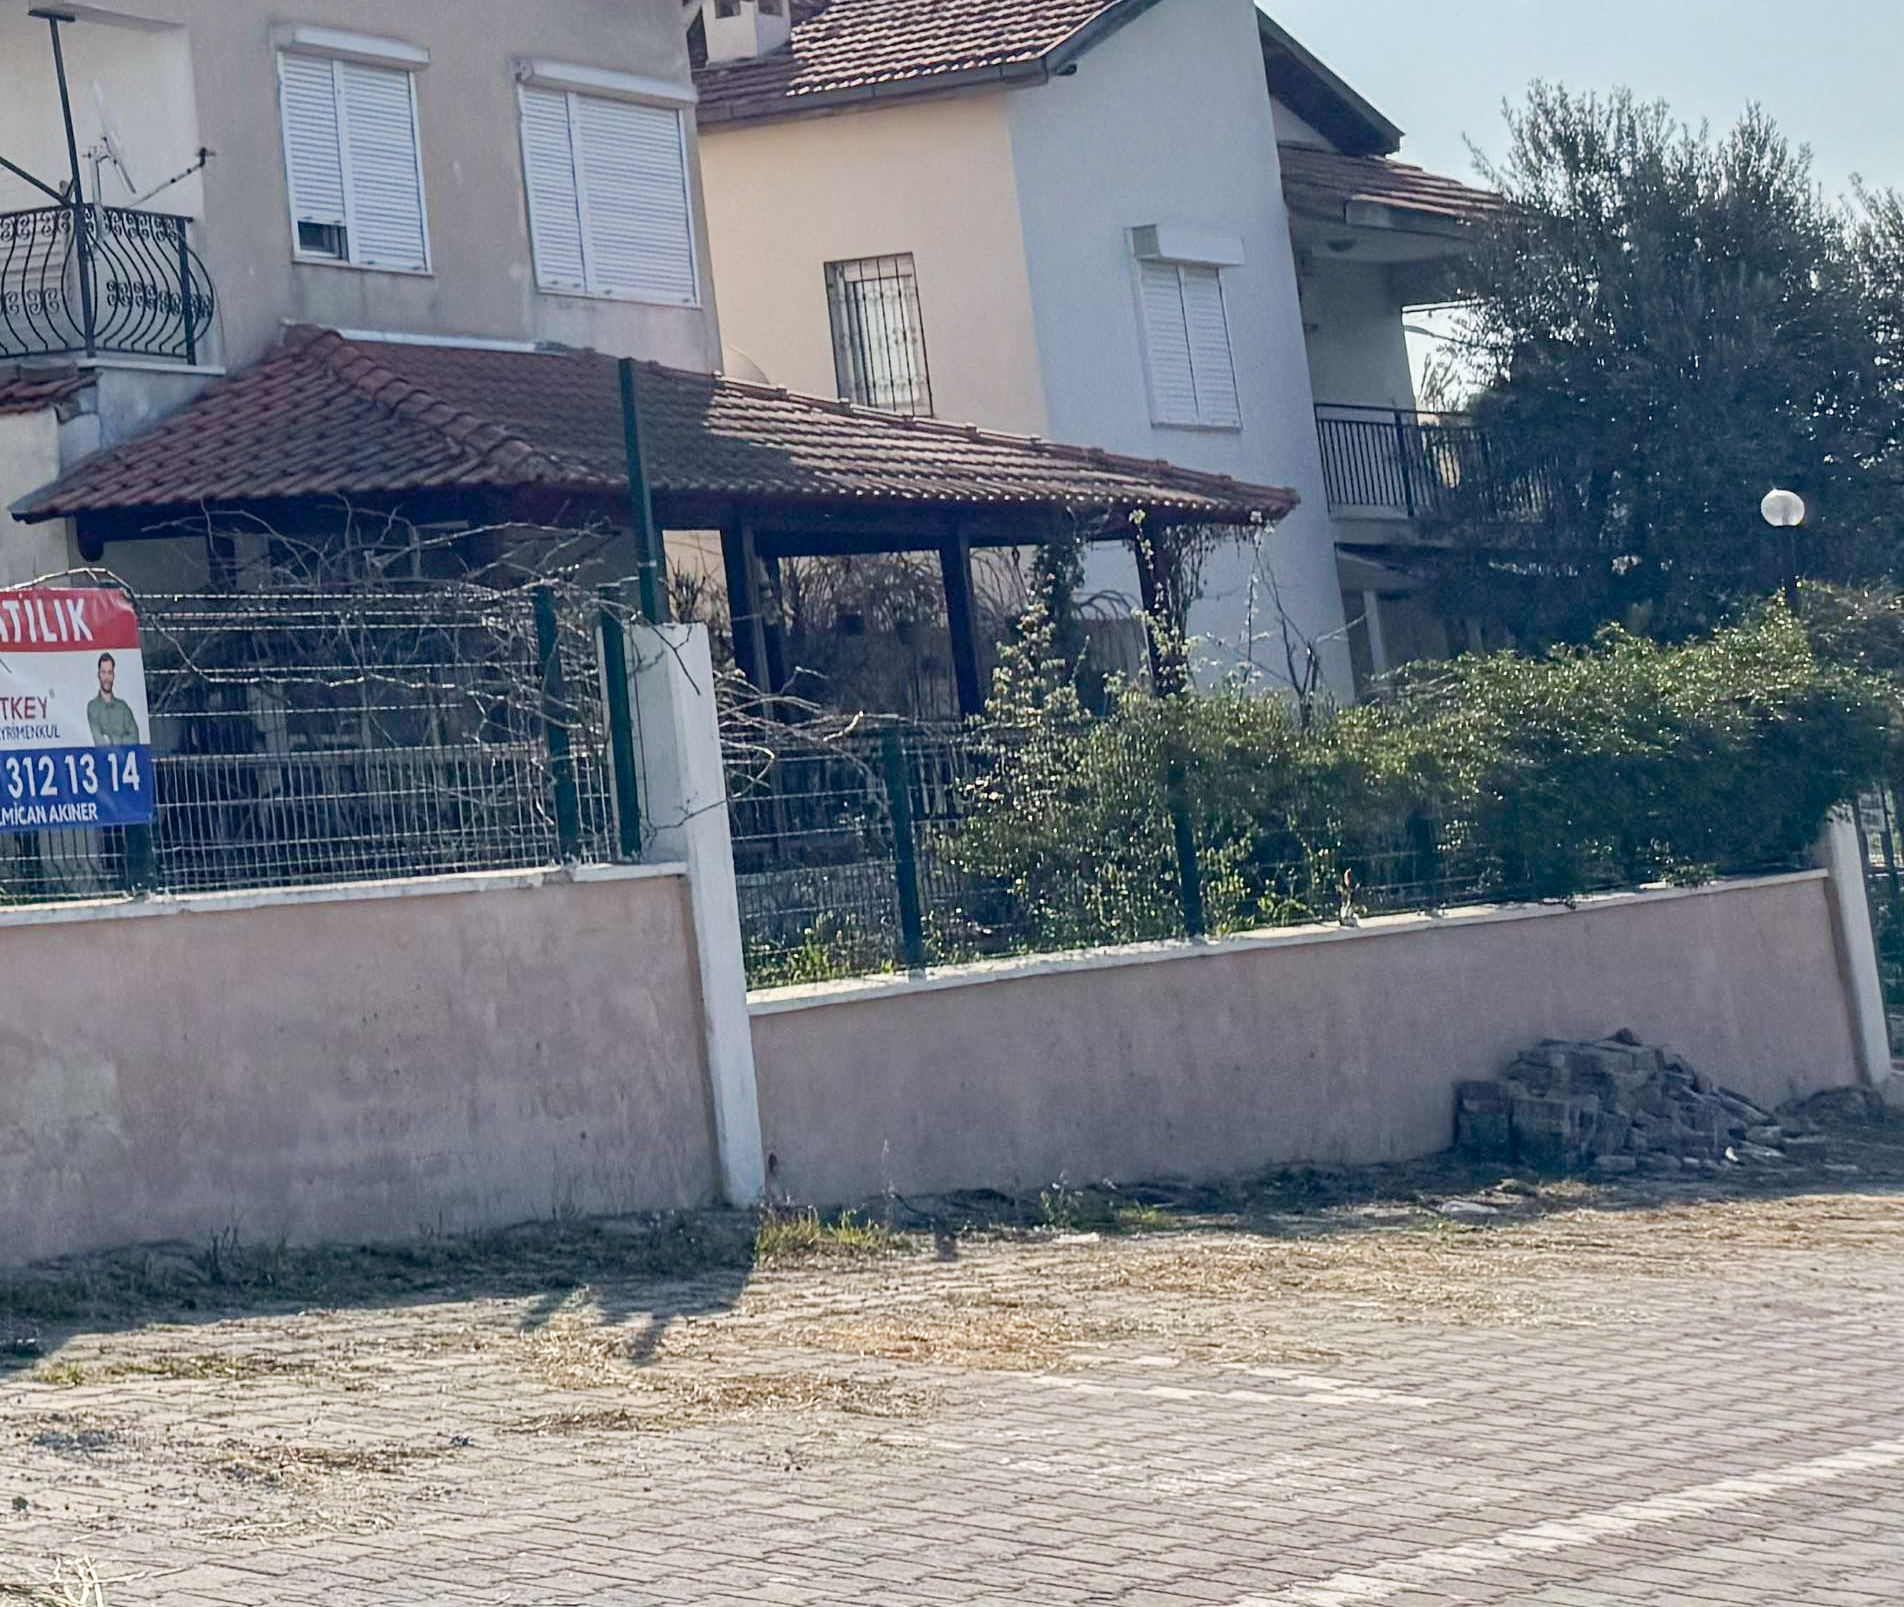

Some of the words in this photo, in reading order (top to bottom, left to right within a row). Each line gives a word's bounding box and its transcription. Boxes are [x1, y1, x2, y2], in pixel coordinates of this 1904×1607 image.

[6, 756, 58, 797] 312
[64, 753, 98, 794] 13
[107, 751, 141, 792] 14
[49, 802, 98, 824] AKINER
